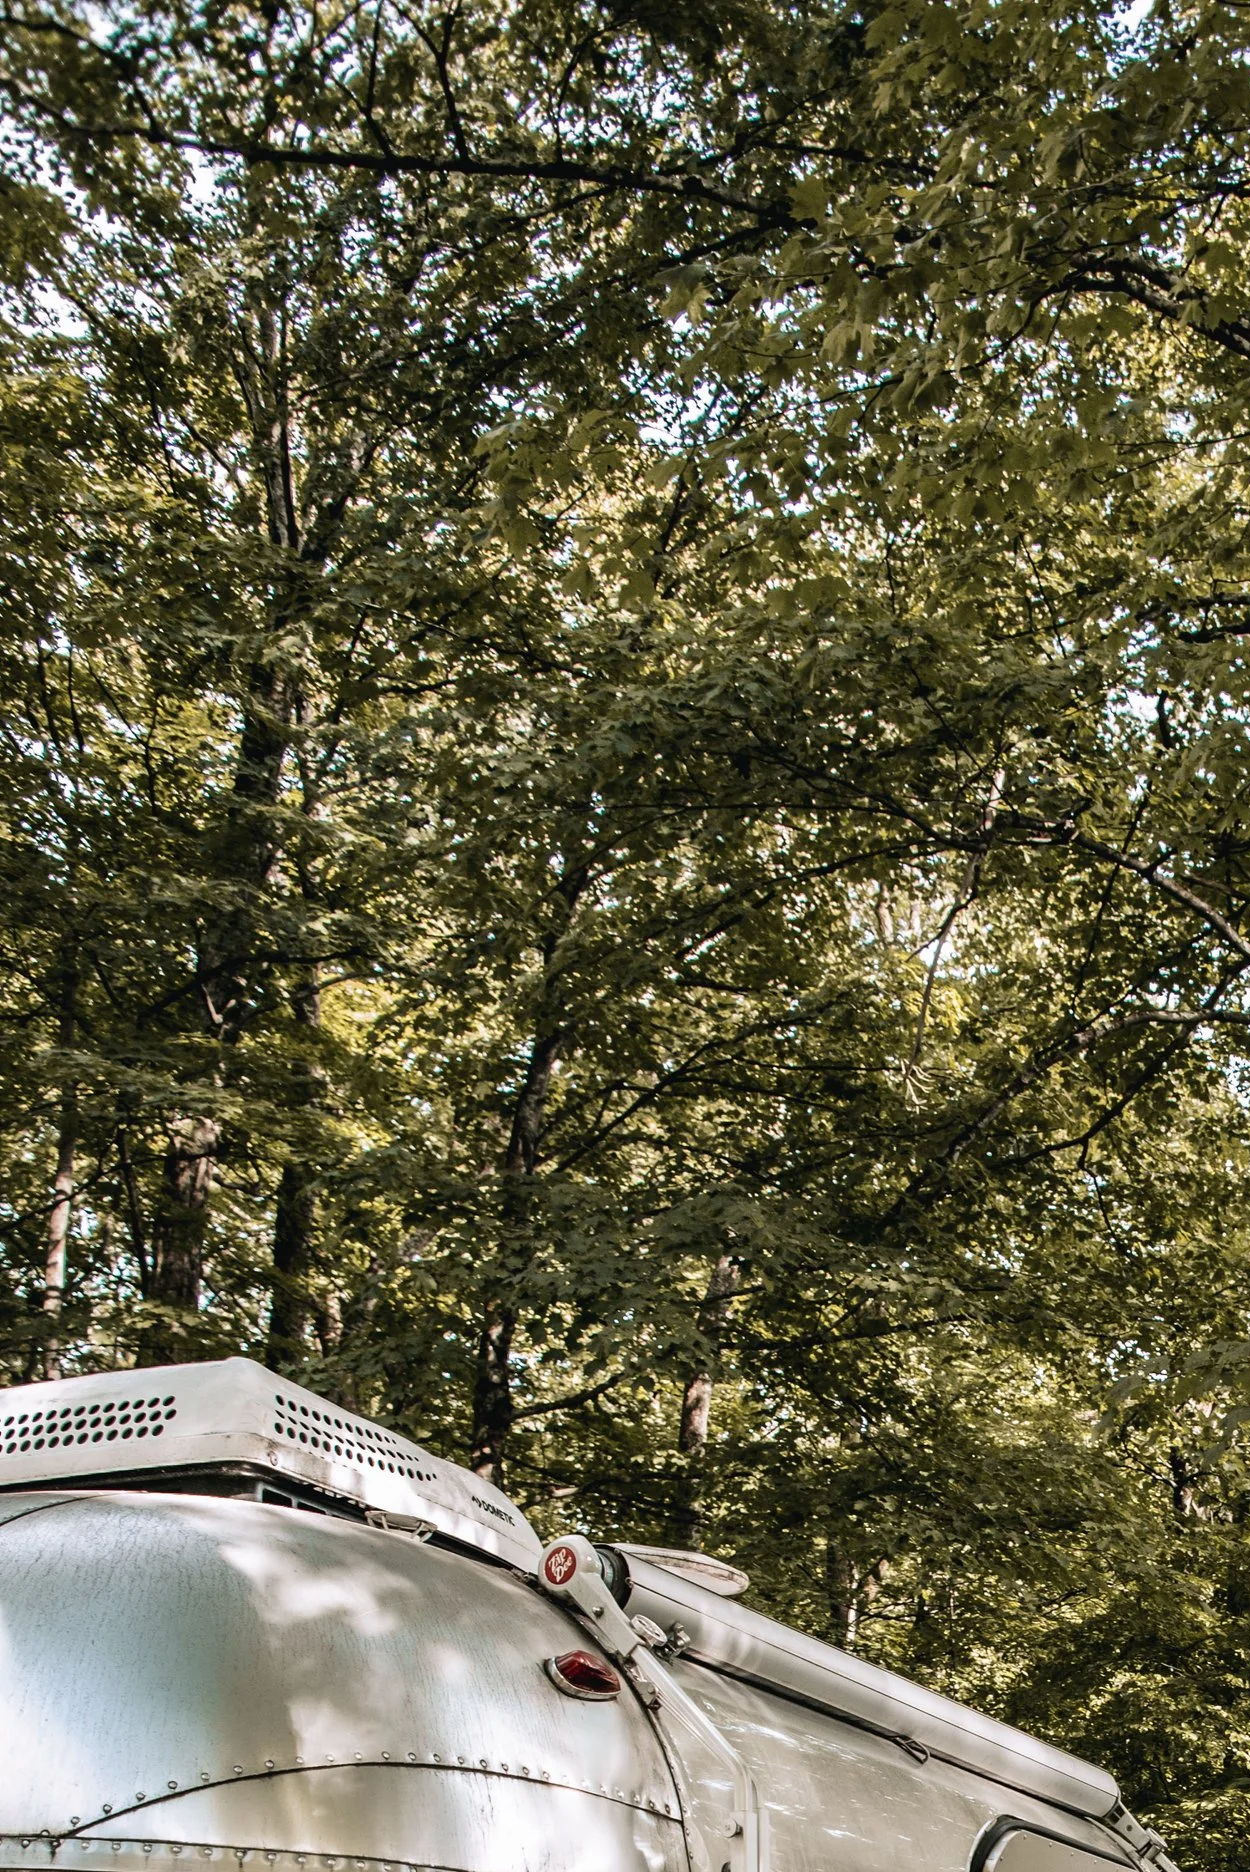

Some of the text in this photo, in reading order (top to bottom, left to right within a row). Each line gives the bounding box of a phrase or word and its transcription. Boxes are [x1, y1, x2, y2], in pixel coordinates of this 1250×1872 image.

[481, 1499, 516, 1527] DOMETIC
[548, 1548, 567, 1577] Zip
[555, 1556, 573, 1583] Dee
